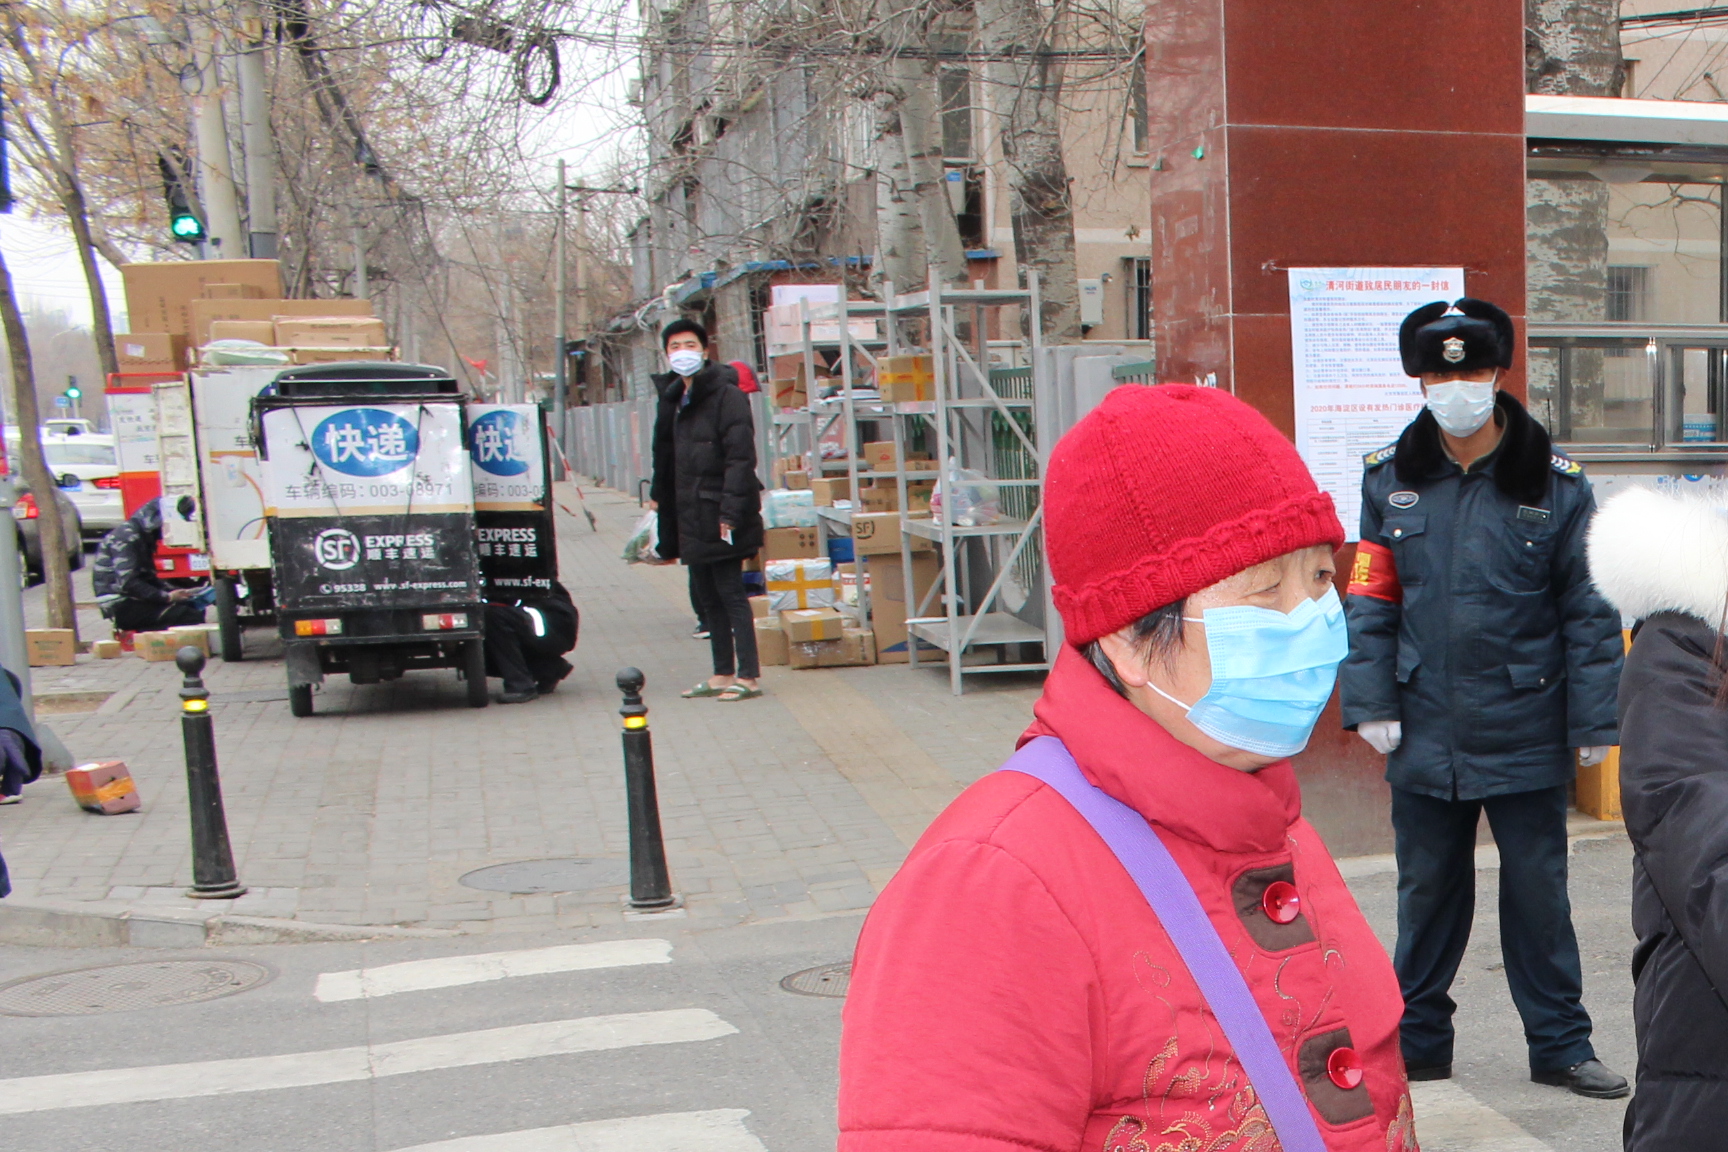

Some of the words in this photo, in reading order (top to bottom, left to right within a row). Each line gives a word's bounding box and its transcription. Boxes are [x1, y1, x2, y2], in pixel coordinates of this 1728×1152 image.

[1325, 280, 1450, 292] 清河街道致居民朋友的一封信
[324, 423, 408, 463] 快递
[364, 534, 434, 548] EXPRESS
[478, 528, 536, 542] EXPRESS
[366, 547, 436, 561] 顺丰速运
[479, 543, 538, 557] 顺丰速运
